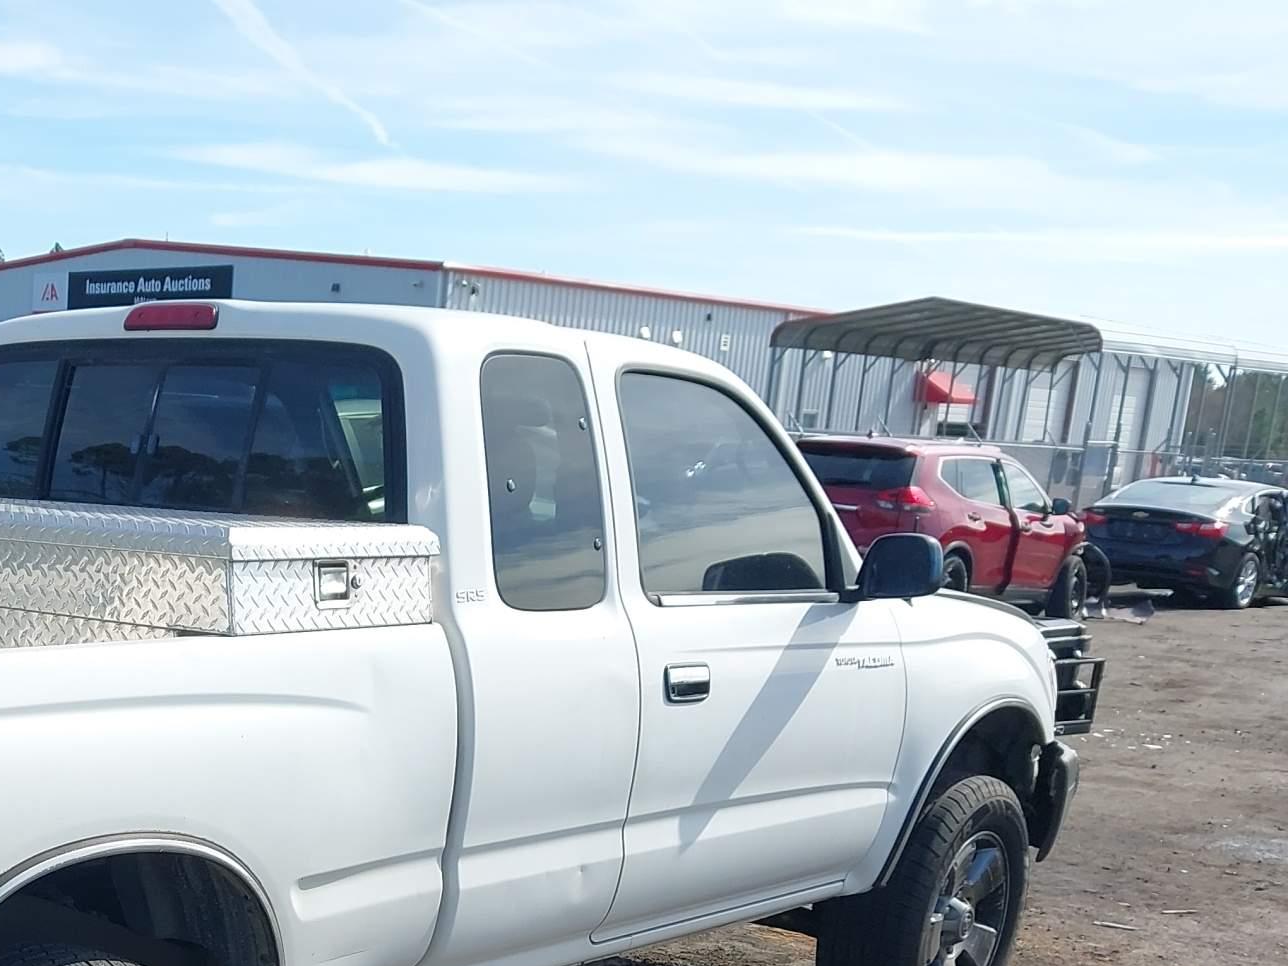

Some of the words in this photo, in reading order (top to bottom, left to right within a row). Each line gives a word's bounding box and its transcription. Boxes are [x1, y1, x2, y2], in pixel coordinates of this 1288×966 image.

[85, 278, 136, 294] Insurance
[137, 276, 162, 293] Auto
[163, 274, 212, 292] Auctions
